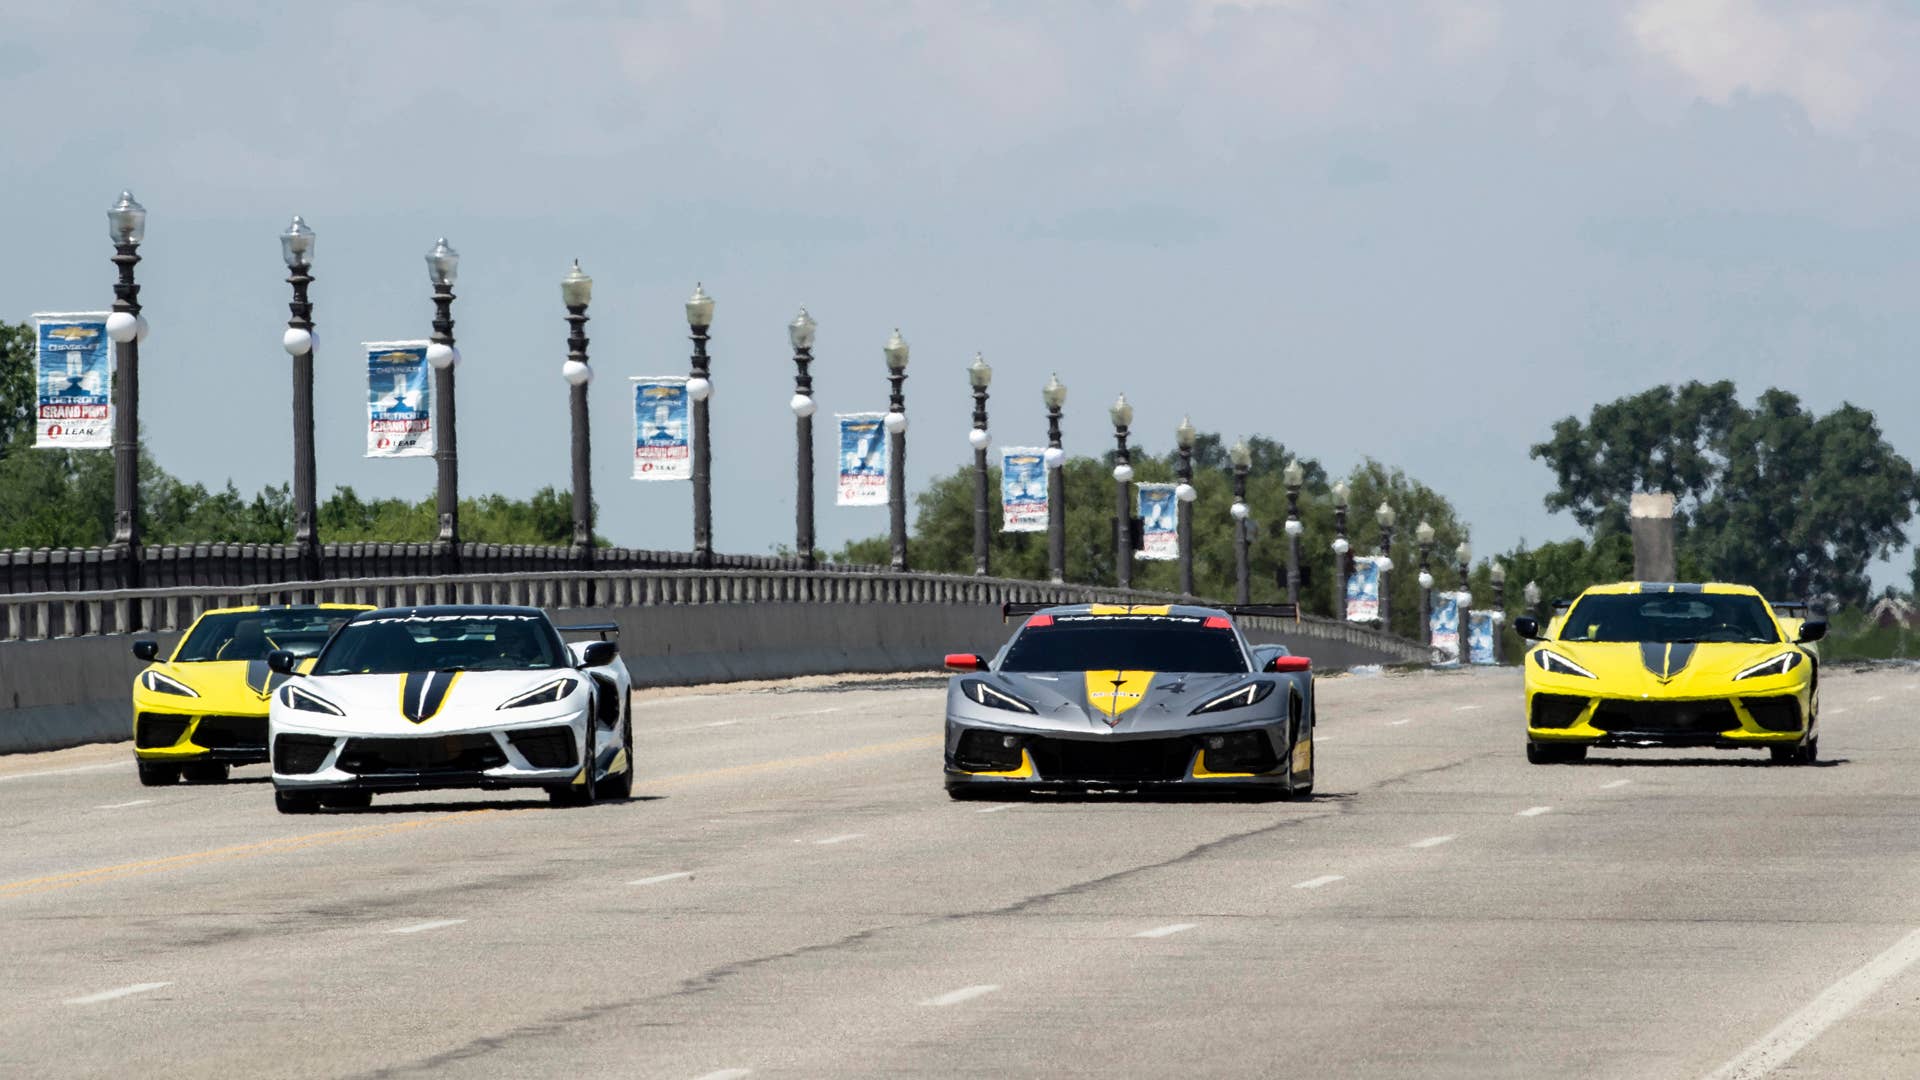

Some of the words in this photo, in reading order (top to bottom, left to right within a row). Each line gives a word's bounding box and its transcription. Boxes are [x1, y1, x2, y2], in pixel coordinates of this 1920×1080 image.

[42, 406, 80, 418] GRAND
[82, 406, 106, 418] PRIX
[65, 428, 94, 436] LEAR
